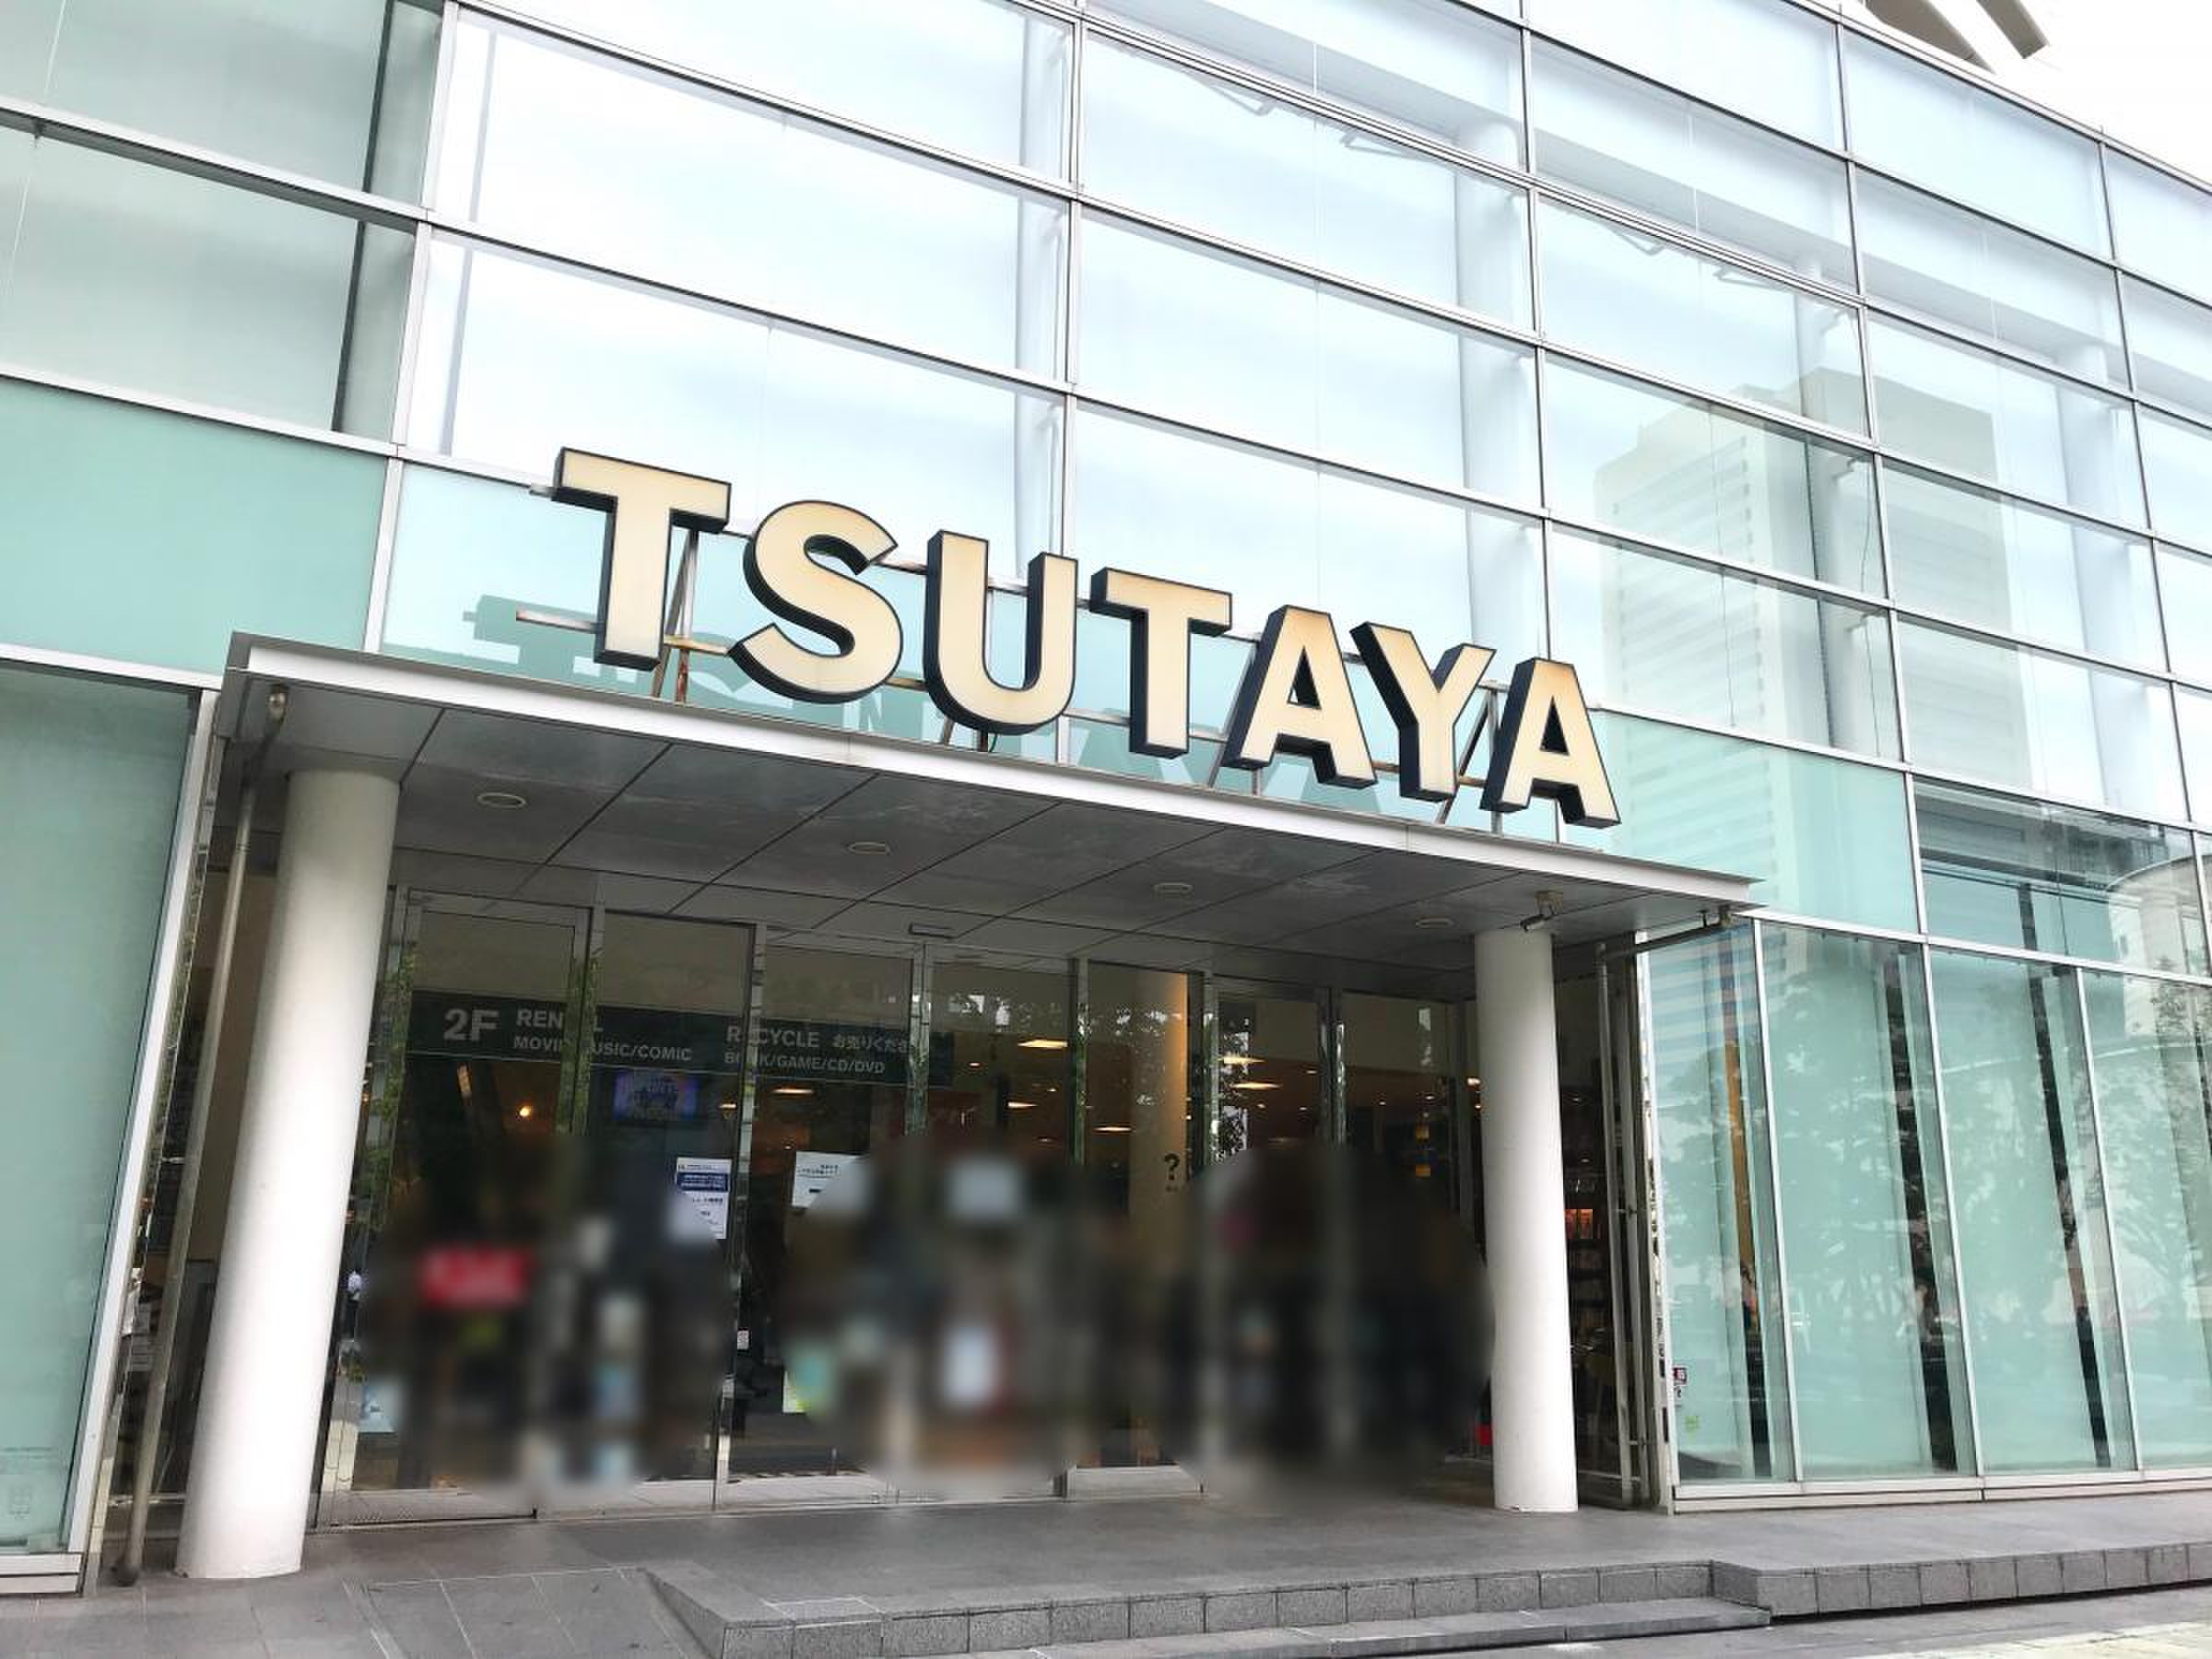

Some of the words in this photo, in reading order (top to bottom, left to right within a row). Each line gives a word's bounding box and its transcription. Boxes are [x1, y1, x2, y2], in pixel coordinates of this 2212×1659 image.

[551, 447, 1621, 828] TSUTAYA
[443, 1008, 500, 1041] 2F
[515, 1008, 604, 1033] RENL
[726, 1025, 820, 1049] RCYCLE
[724, 1051, 886, 1075] BK/GAME/CD/DVD
